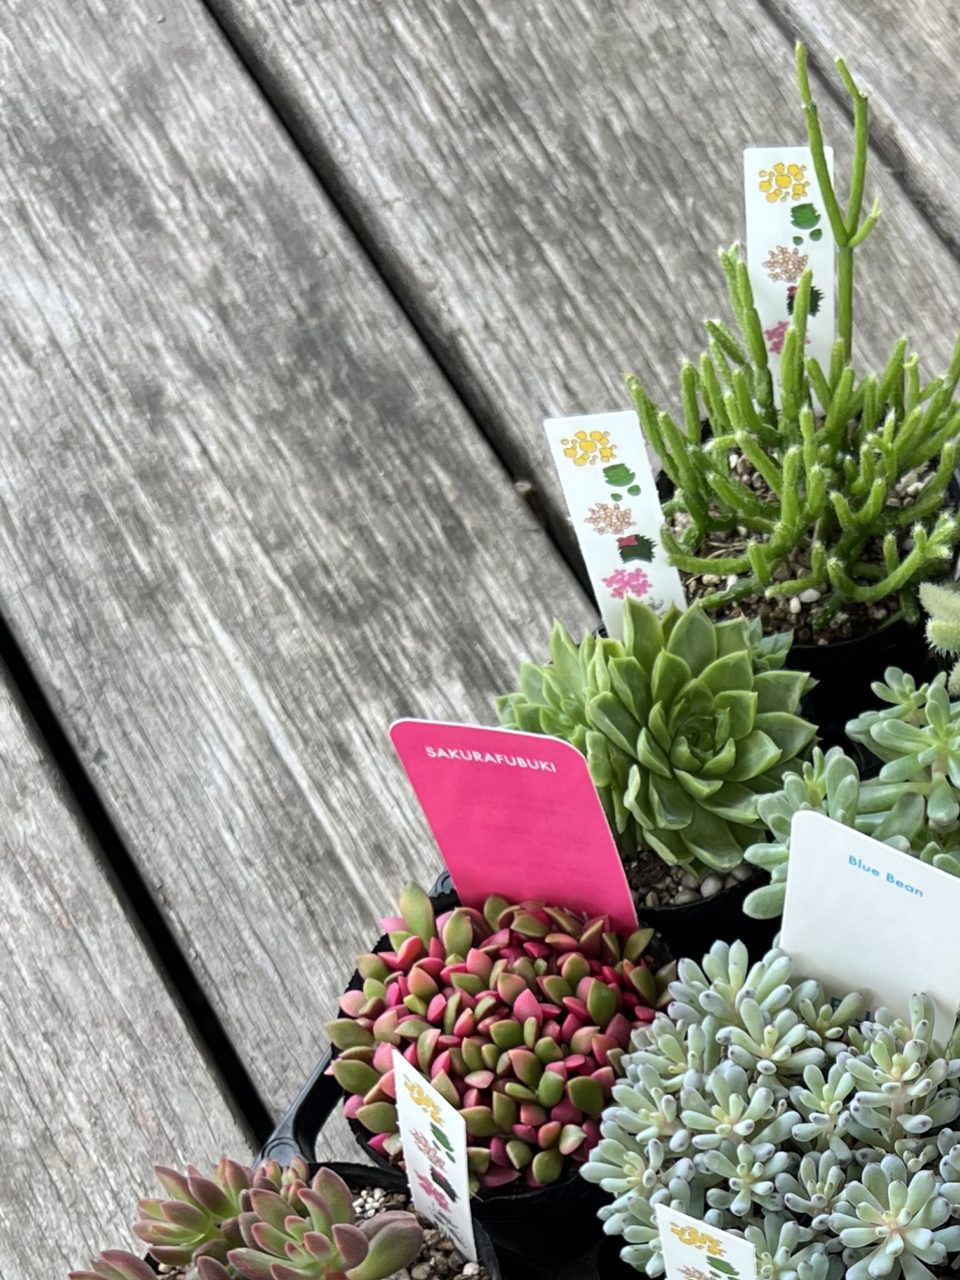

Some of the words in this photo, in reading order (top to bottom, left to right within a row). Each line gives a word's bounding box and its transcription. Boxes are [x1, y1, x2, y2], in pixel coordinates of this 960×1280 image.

[425, 746, 557, 773] SAKURAFUBUKI
[848, 854, 880, 877] Blue
[886, 872, 924, 898] Bean
